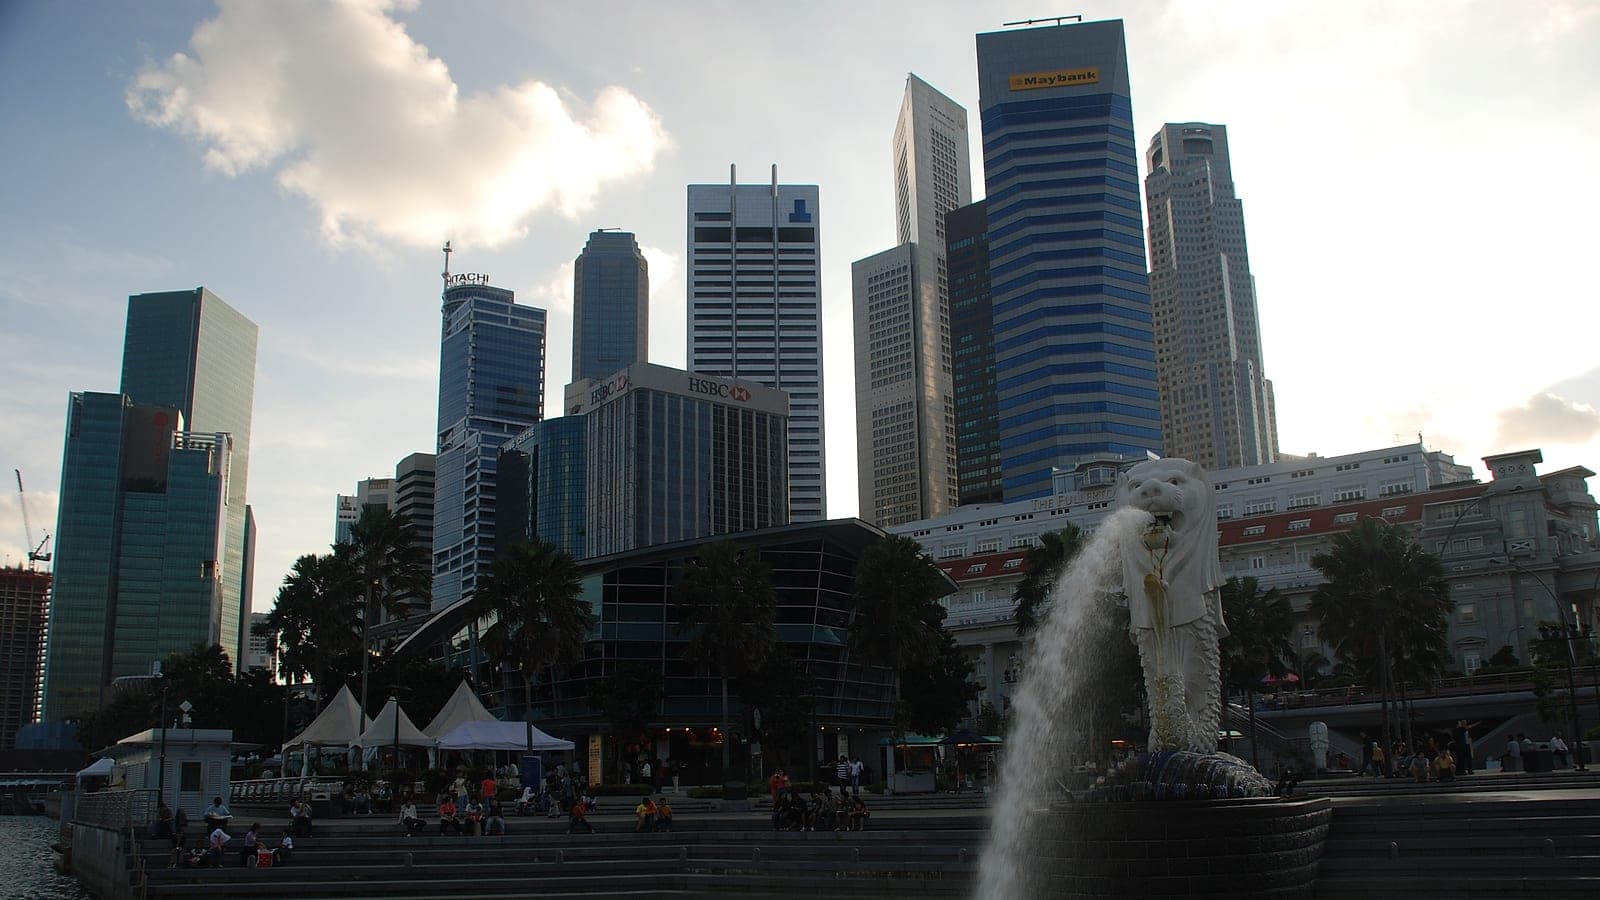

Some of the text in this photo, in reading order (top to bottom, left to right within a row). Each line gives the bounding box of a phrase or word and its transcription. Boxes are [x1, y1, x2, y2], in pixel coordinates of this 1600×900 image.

[1023, 71, 1097, 85] Maybank
[591, 381, 615, 405] HSBC
[687, 377, 729, 398] HSBC
[1032, 498, 1054, 511] THE
